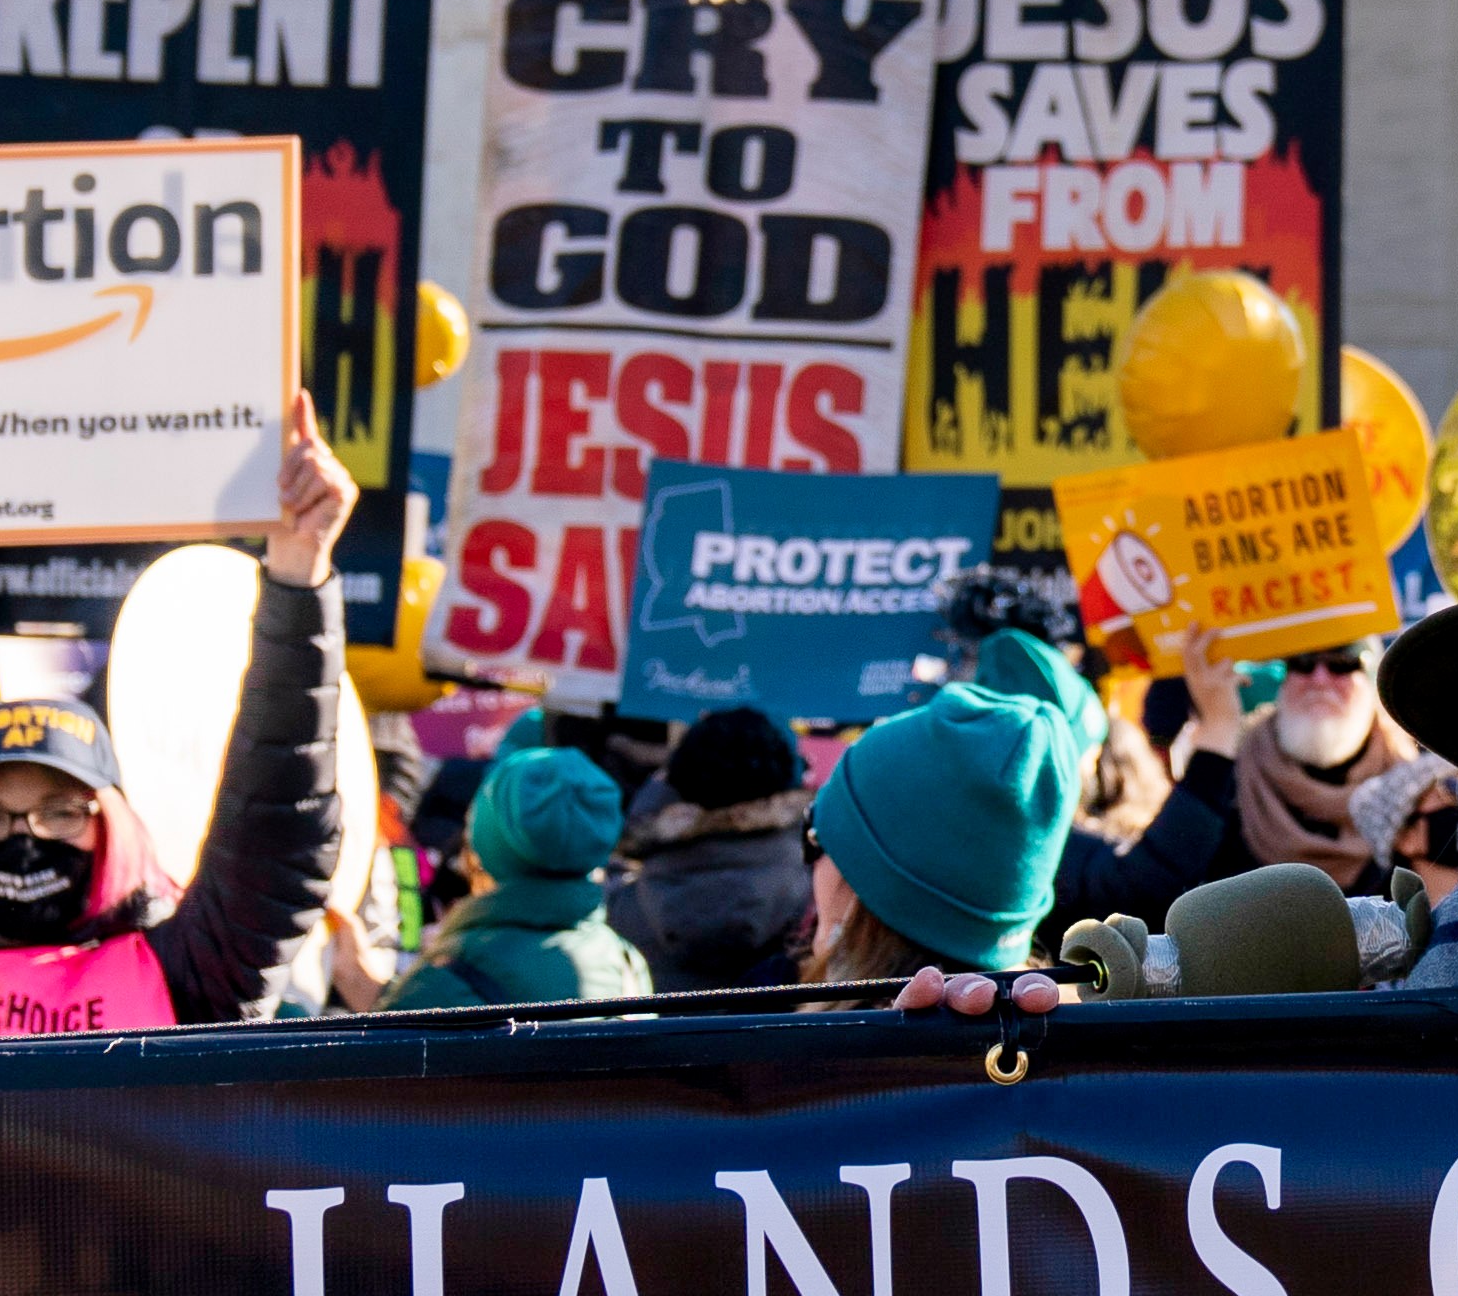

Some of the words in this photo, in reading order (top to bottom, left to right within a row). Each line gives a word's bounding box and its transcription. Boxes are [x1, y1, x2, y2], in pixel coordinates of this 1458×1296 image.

[954, 61, 1277, 165] SAVES
[599, 118, 799, 202] TO
[979, 159, 1244, 253] FROM
[489, 204, 892, 325] GOD
[78, 413, 139, 442] you
[146, 406, 223, 432] want
[231, 404, 264, 429] it.
[479, 350, 867, 497] JESUS
[1183, 467, 1347, 530] ABORTION
[690, 530, 972, 586] PROTECT
[1193, 526, 1282, 575] BANS
[1293, 511, 1354, 558] ARE
[684, 581, 840, 616] ABORTION
[841, 586, 940, 616] ACCES
